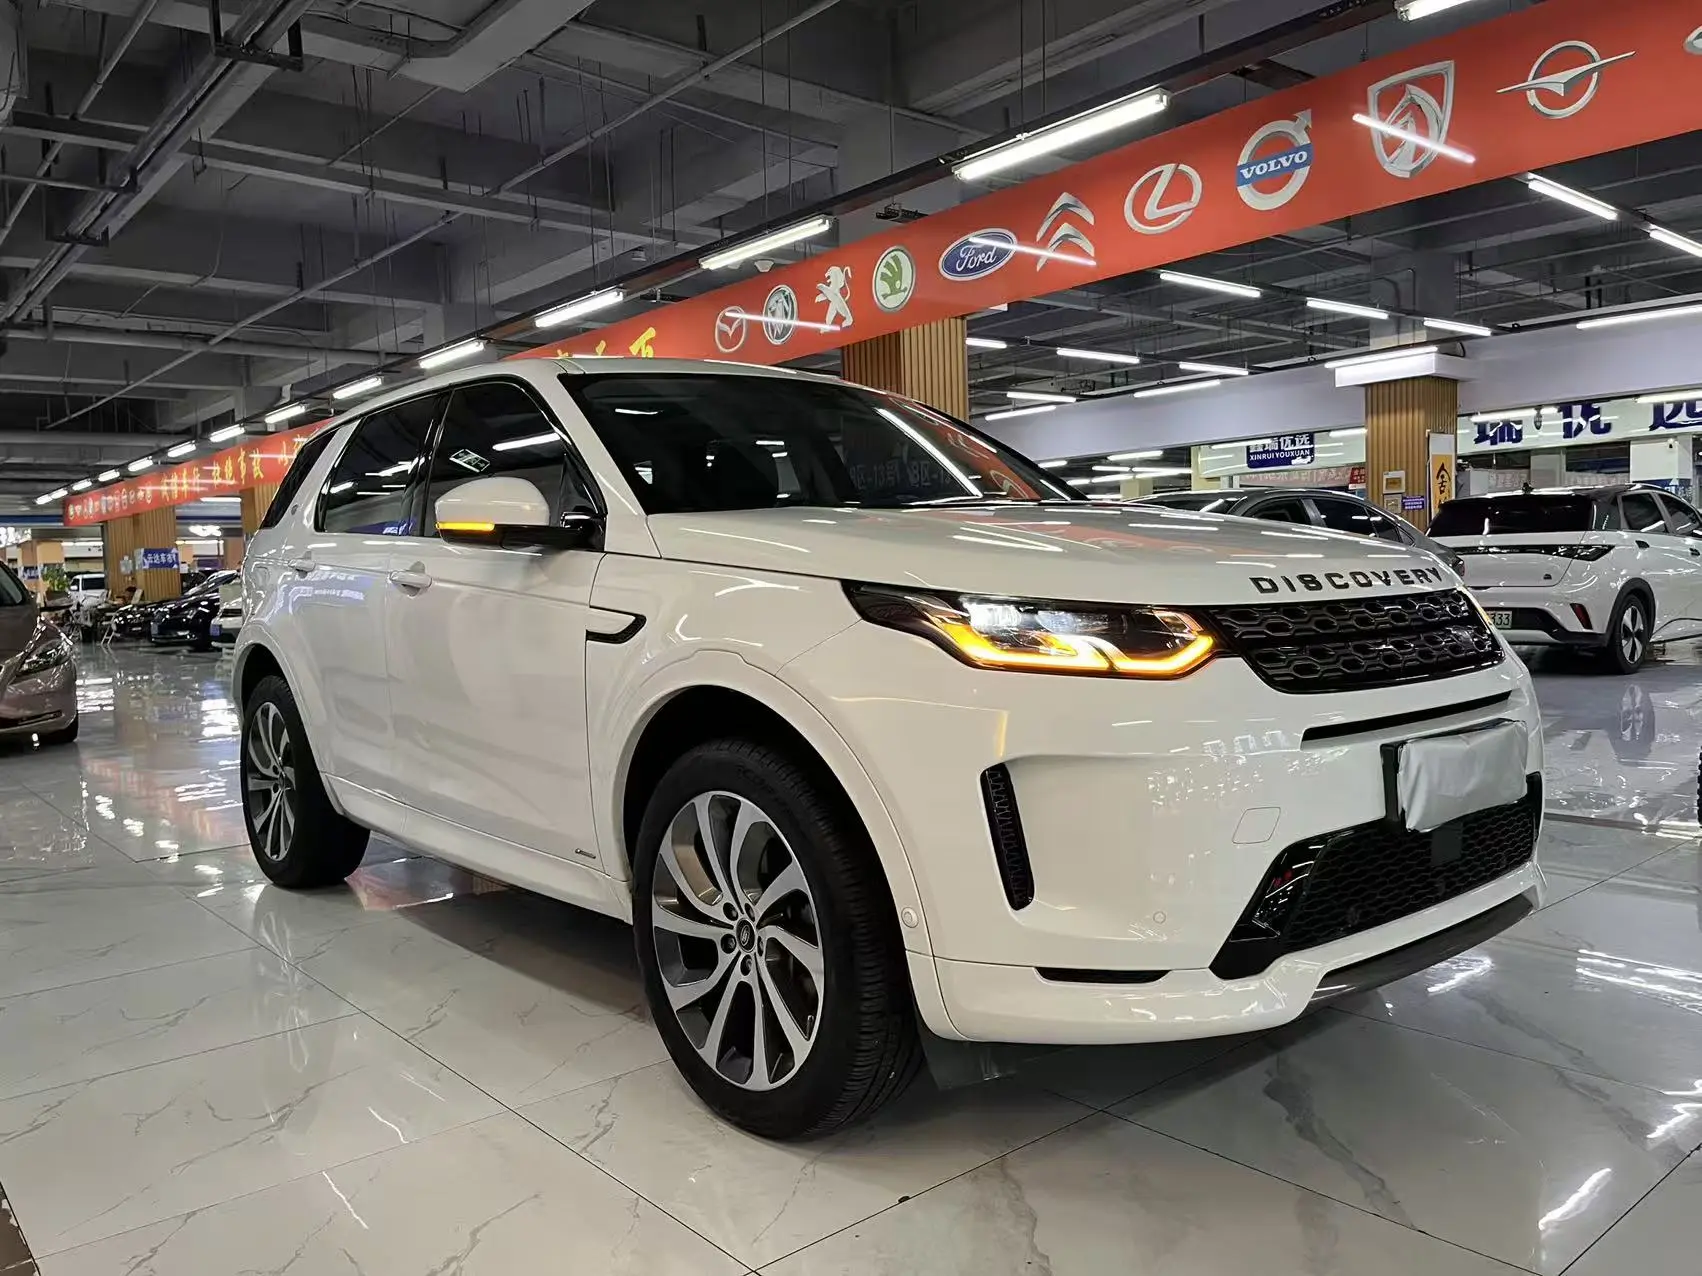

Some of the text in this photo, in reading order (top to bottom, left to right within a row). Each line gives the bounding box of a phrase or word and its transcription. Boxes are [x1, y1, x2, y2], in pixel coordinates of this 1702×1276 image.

[1240, 150, 1308, 181] VOLVO
[955, 243, 997, 272] Ford
[1249, 449, 1311, 461] XINRUI YOUXUAN
[1249, 566, 1443, 594] DISCOVERY
